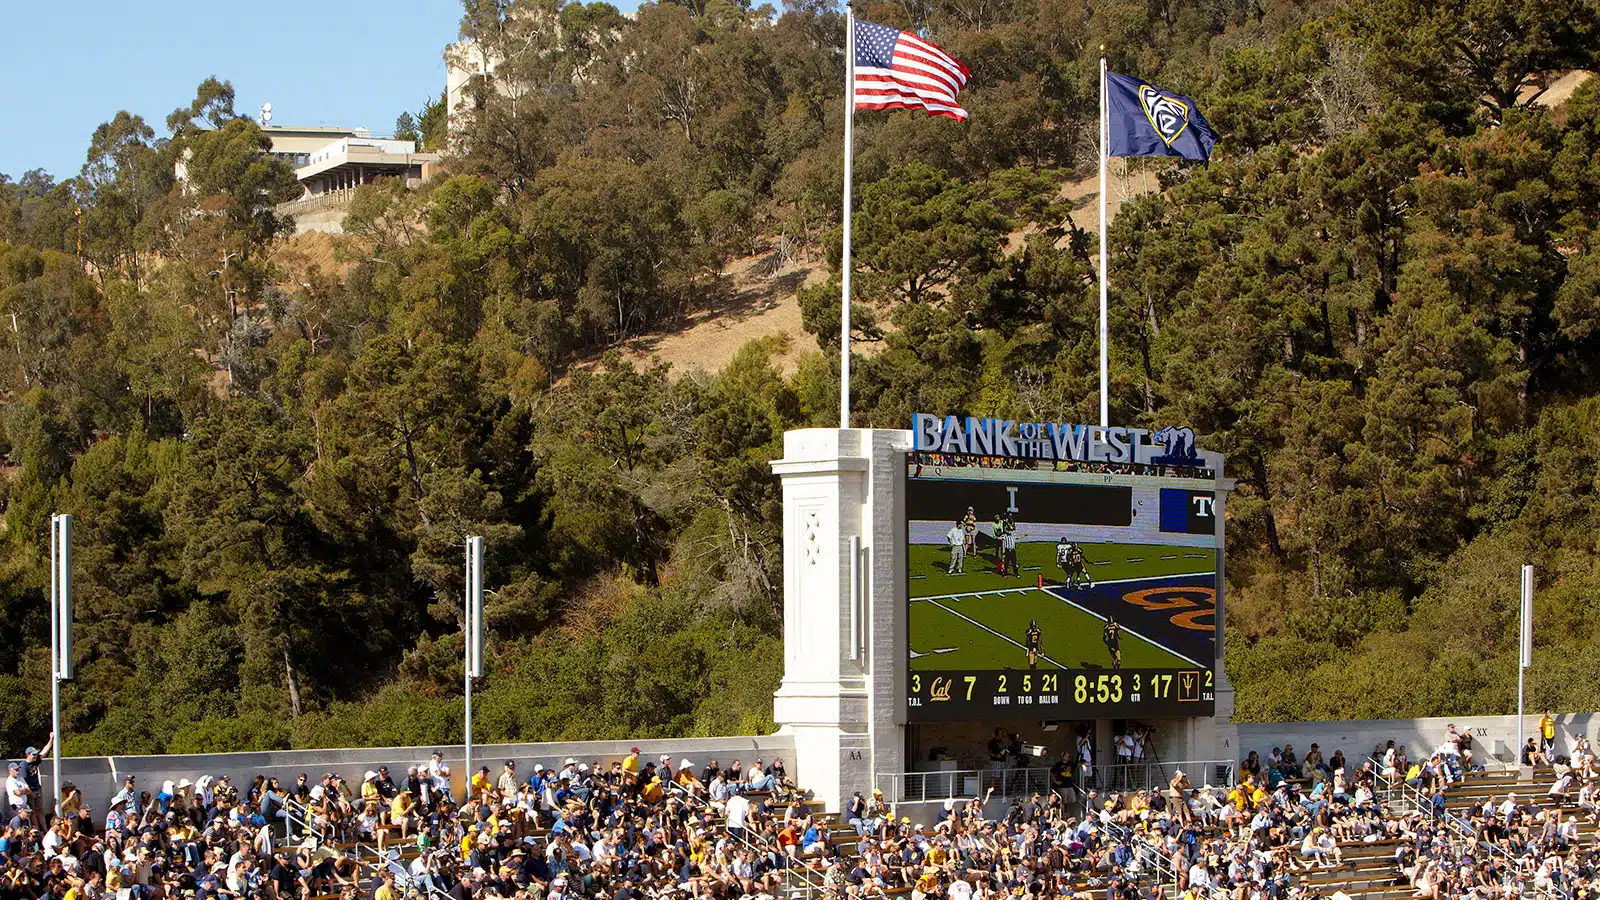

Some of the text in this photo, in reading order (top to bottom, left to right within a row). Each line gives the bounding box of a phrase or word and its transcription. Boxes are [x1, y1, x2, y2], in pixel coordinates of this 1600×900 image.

[912, 413, 1148, 464] BANK OF THE WEST
[1194, 496, 1215, 516] T
[912, 674, 921, 693] 3
[998, 675, 1007, 692] 2
[1023, 675, 1032, 692] 5
[1042, 674, 1057, 692] 21
[1132, 674, 1141, 691] 3
[1150, 674, 1172, 698] 17
[1205, 670, 1213, 687] 2
[930, 676, 952, 701] Cal
[964, 676, 977, 701] 7
[1074, 675, 1123, 703] 8:53
[993, 696, 1010, 705] DOWN
[1476, 728, 1488, 737] XX
[849, 751, 862, 760] AA
